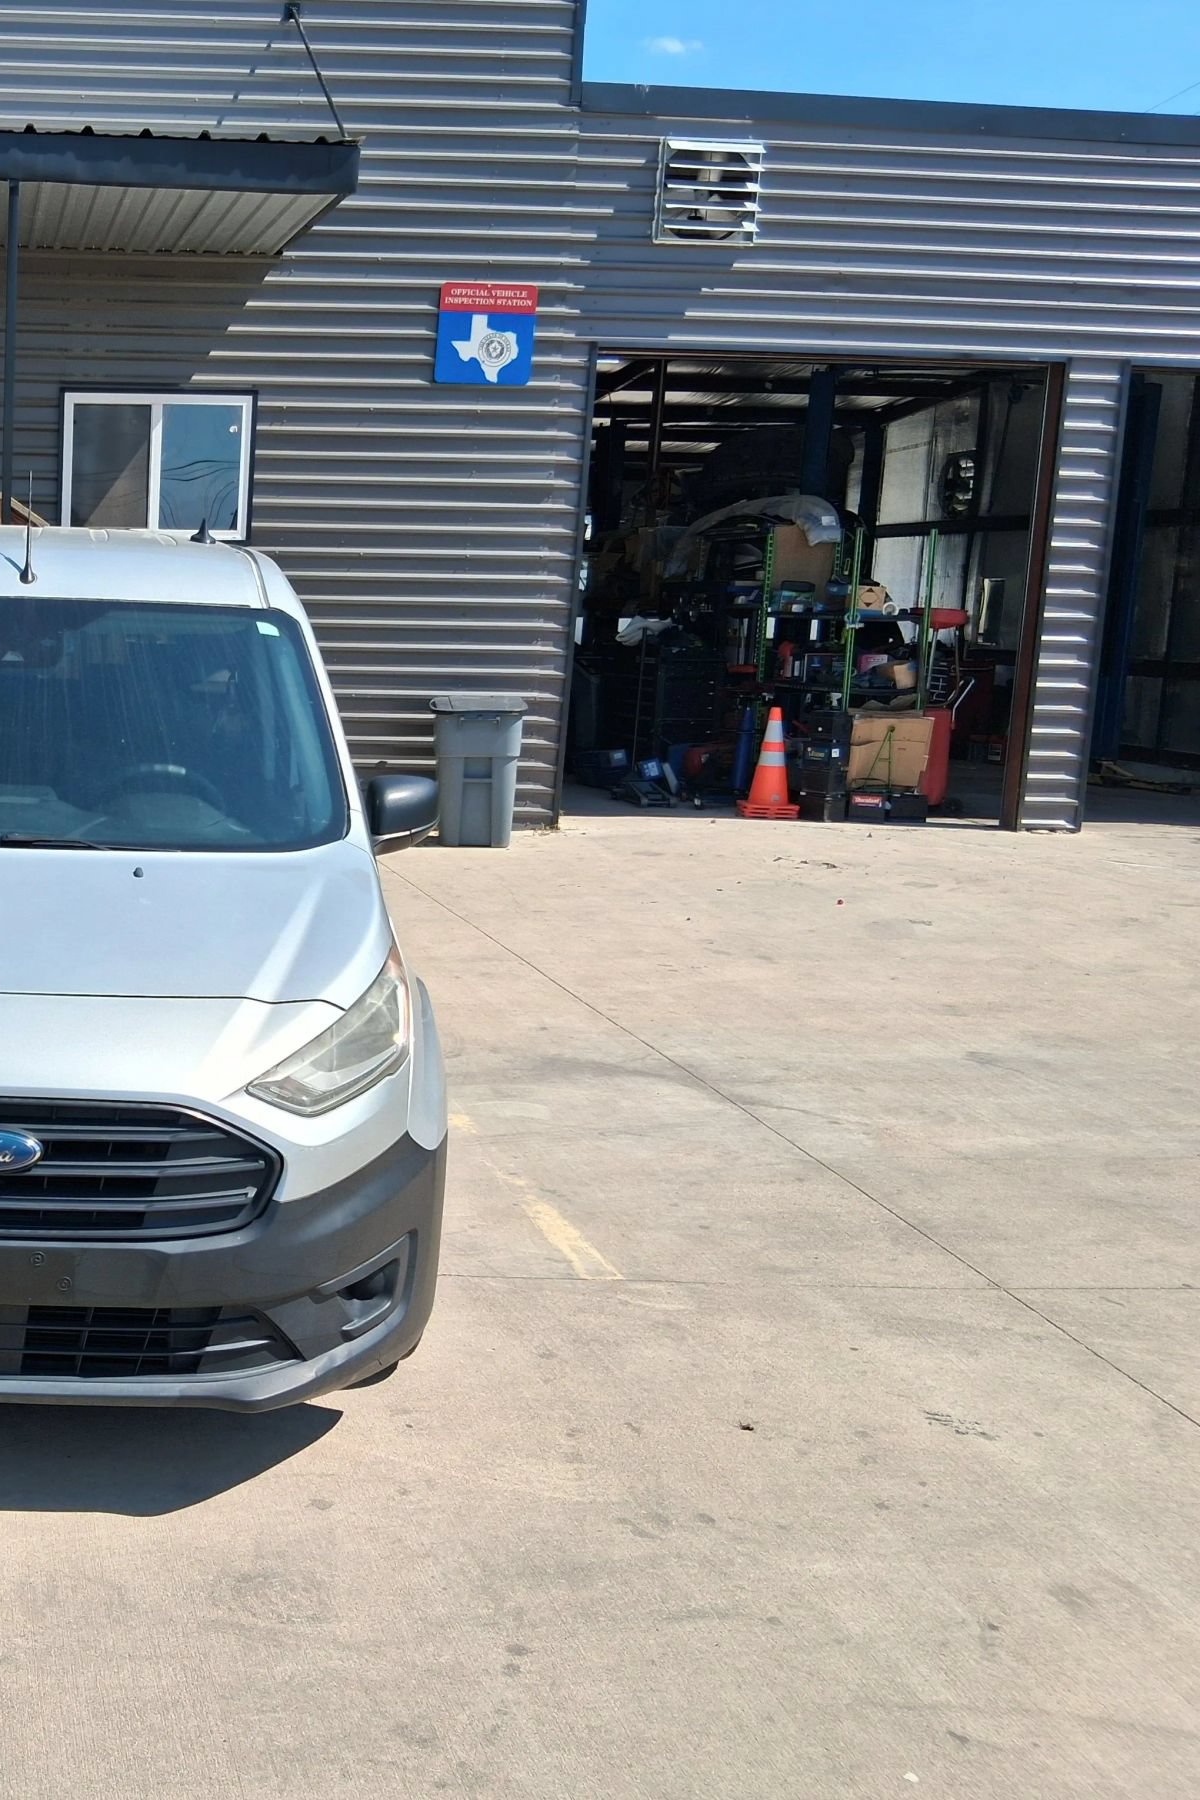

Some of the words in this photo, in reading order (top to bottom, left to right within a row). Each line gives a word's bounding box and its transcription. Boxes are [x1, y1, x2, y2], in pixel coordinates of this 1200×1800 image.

[451, 288, 490, 297] OFFICIAL
[492, 289, 527, 298] VEHICLE
[445, 297, 495, 305] INSPECTION
[496, 298, 533, 307] STATION
